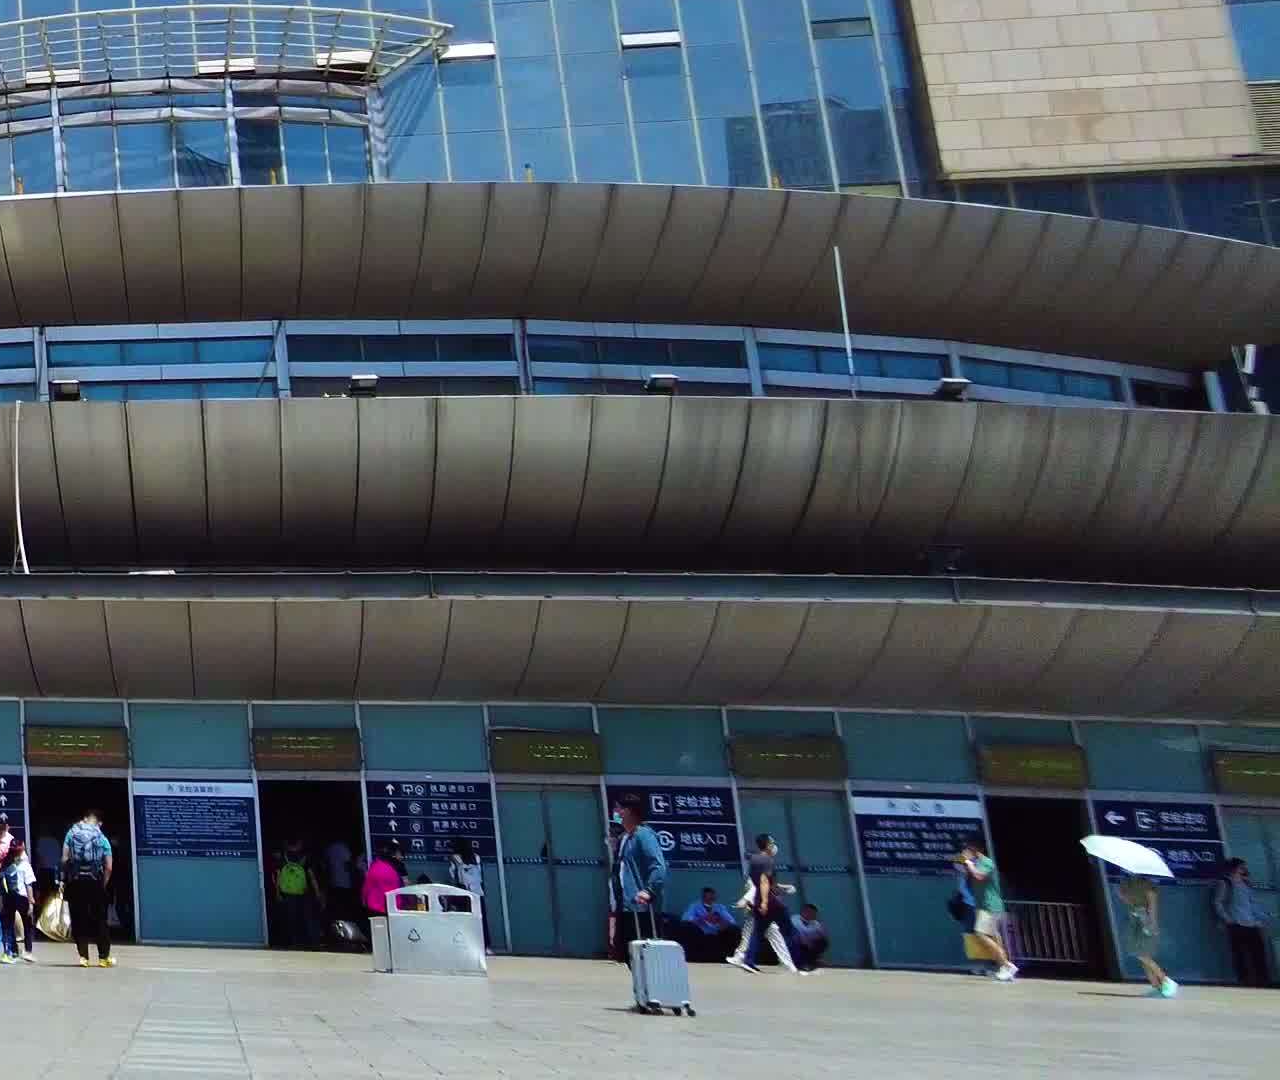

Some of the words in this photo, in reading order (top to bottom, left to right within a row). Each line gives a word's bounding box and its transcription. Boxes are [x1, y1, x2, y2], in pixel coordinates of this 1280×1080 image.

[674, 795, 722, 809] 安检进站
[680, 832, 729, 846] 地铁入口
